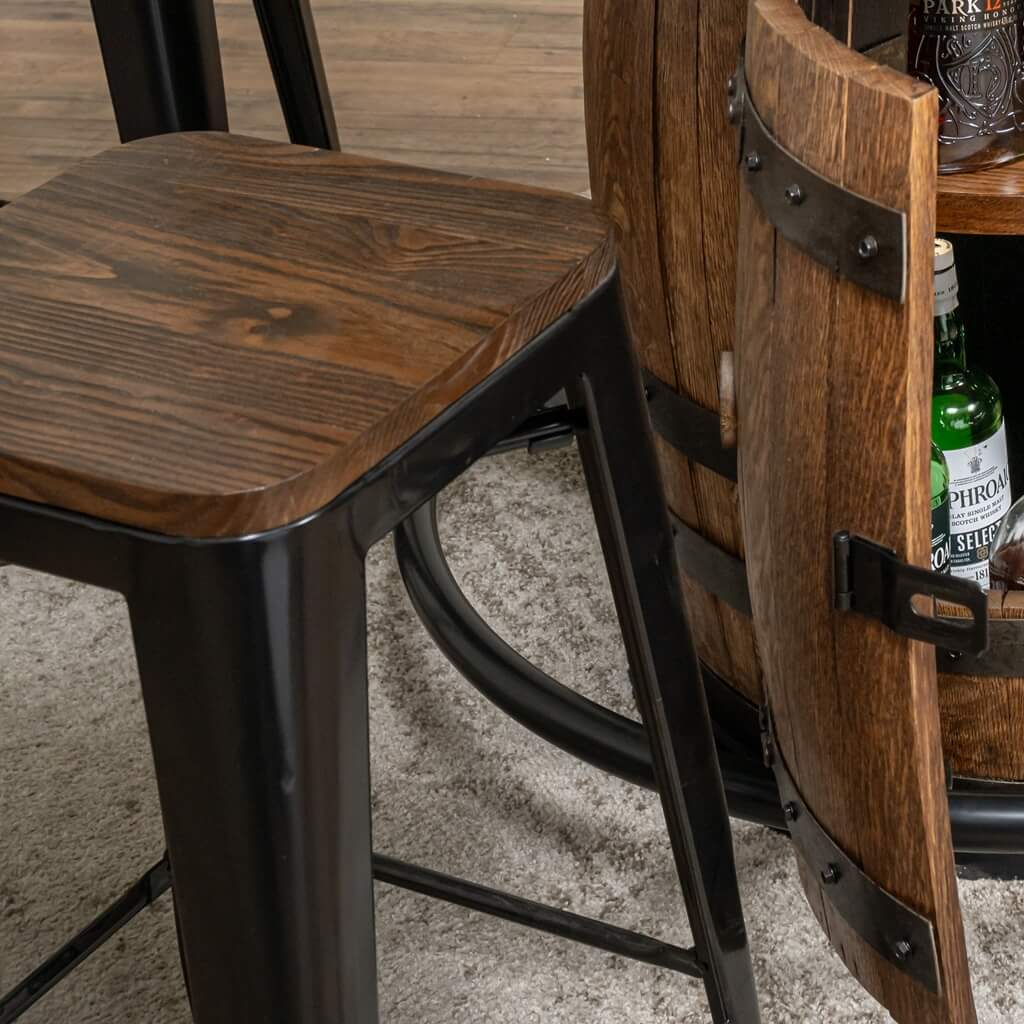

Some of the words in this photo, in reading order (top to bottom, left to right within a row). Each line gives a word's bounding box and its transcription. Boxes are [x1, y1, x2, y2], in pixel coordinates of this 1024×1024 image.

[961, 23, 981, 31] SCOTCH
[967, 504, 991, 516] SINGLE
[951, 517, 979, 527] SCOTCH
